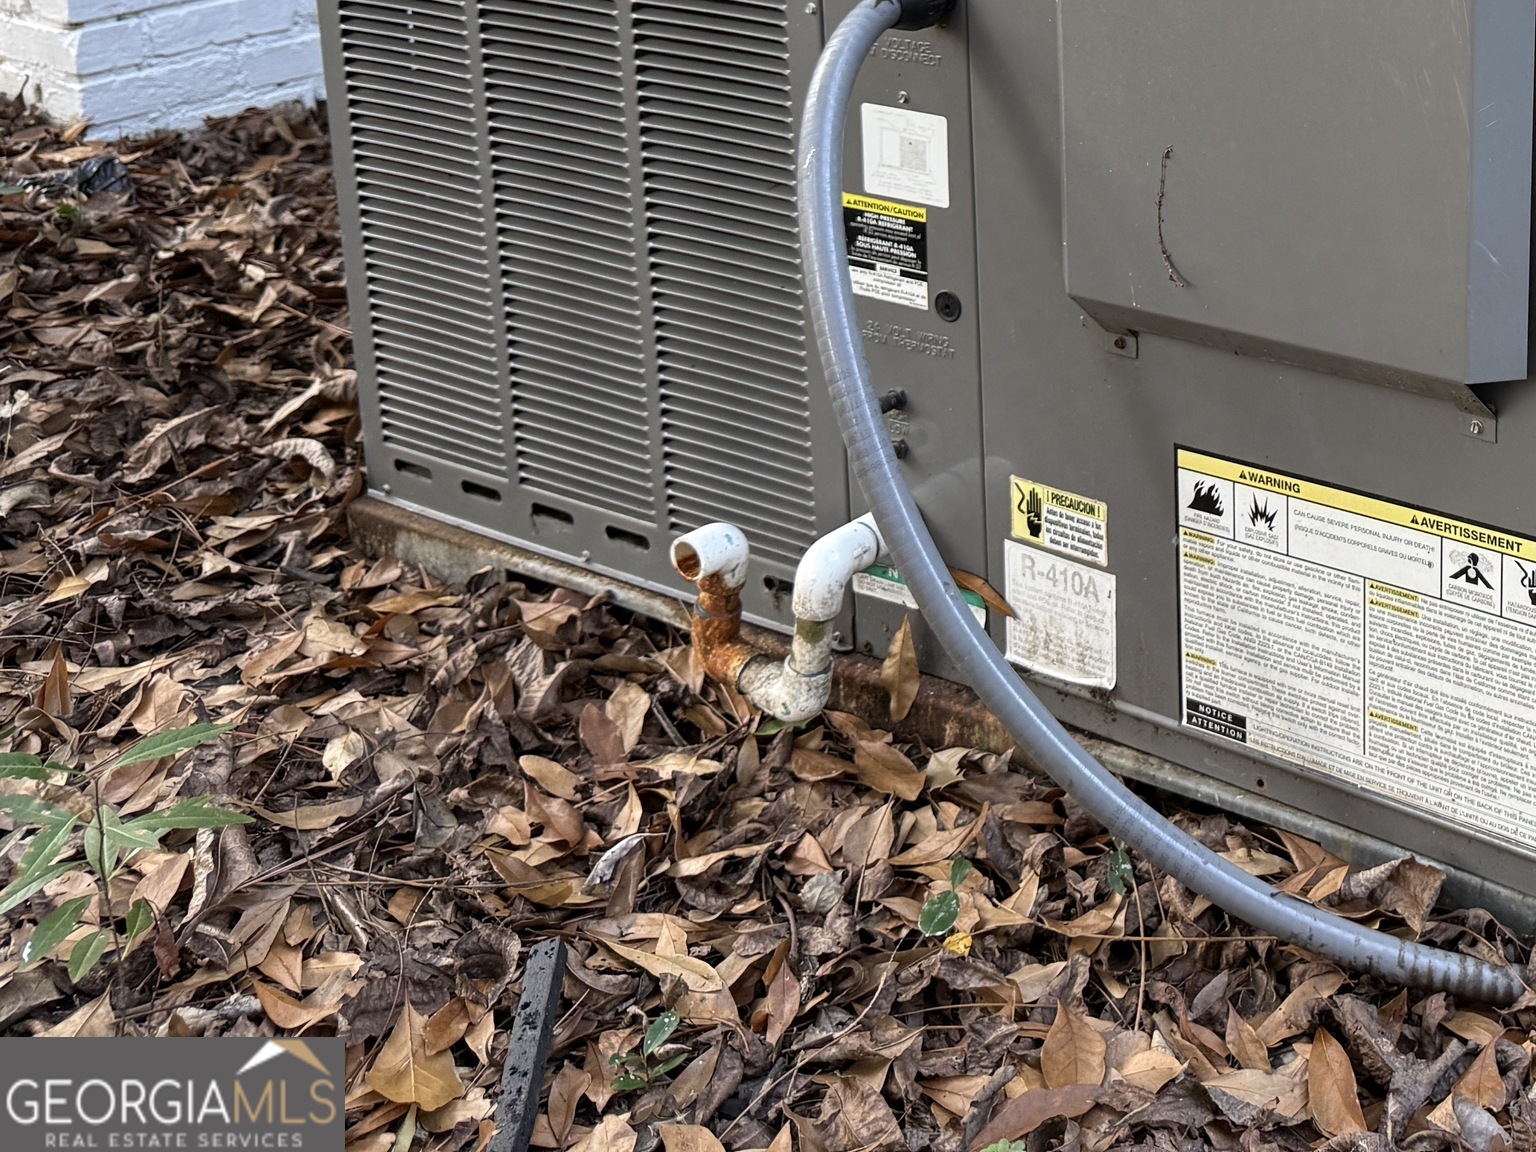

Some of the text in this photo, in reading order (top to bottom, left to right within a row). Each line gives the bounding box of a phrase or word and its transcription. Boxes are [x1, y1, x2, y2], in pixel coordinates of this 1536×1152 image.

[852, 199, 924, 219] ATTENTION/CAUTION
[867, 320, 880, 331] 24
[893, 336, 955, 359] THERMOSTAT
[1247, 470, 1300, 494] WARNING
[1051, 492, 1095, 516] PRECAUCION
[1293, 508, 1305, 518] CAN
[1307, 512, 1325, 523] CAUSE
[1326, 517, 1348, 529] SEVERE
[1350, 524, 1380, 538] PERSONAL
[1382, 532, 1402, 544] INJURY
[1403, 538, 1412, 547] OR
[1420, 515, 1522, 553] AVERTISSEMENT
[1022, 553, 1099, 603] R-410A
[1198, 703, 1232, 723] NOTICE
[1191, 715, 1242, 740] ATTENTION
